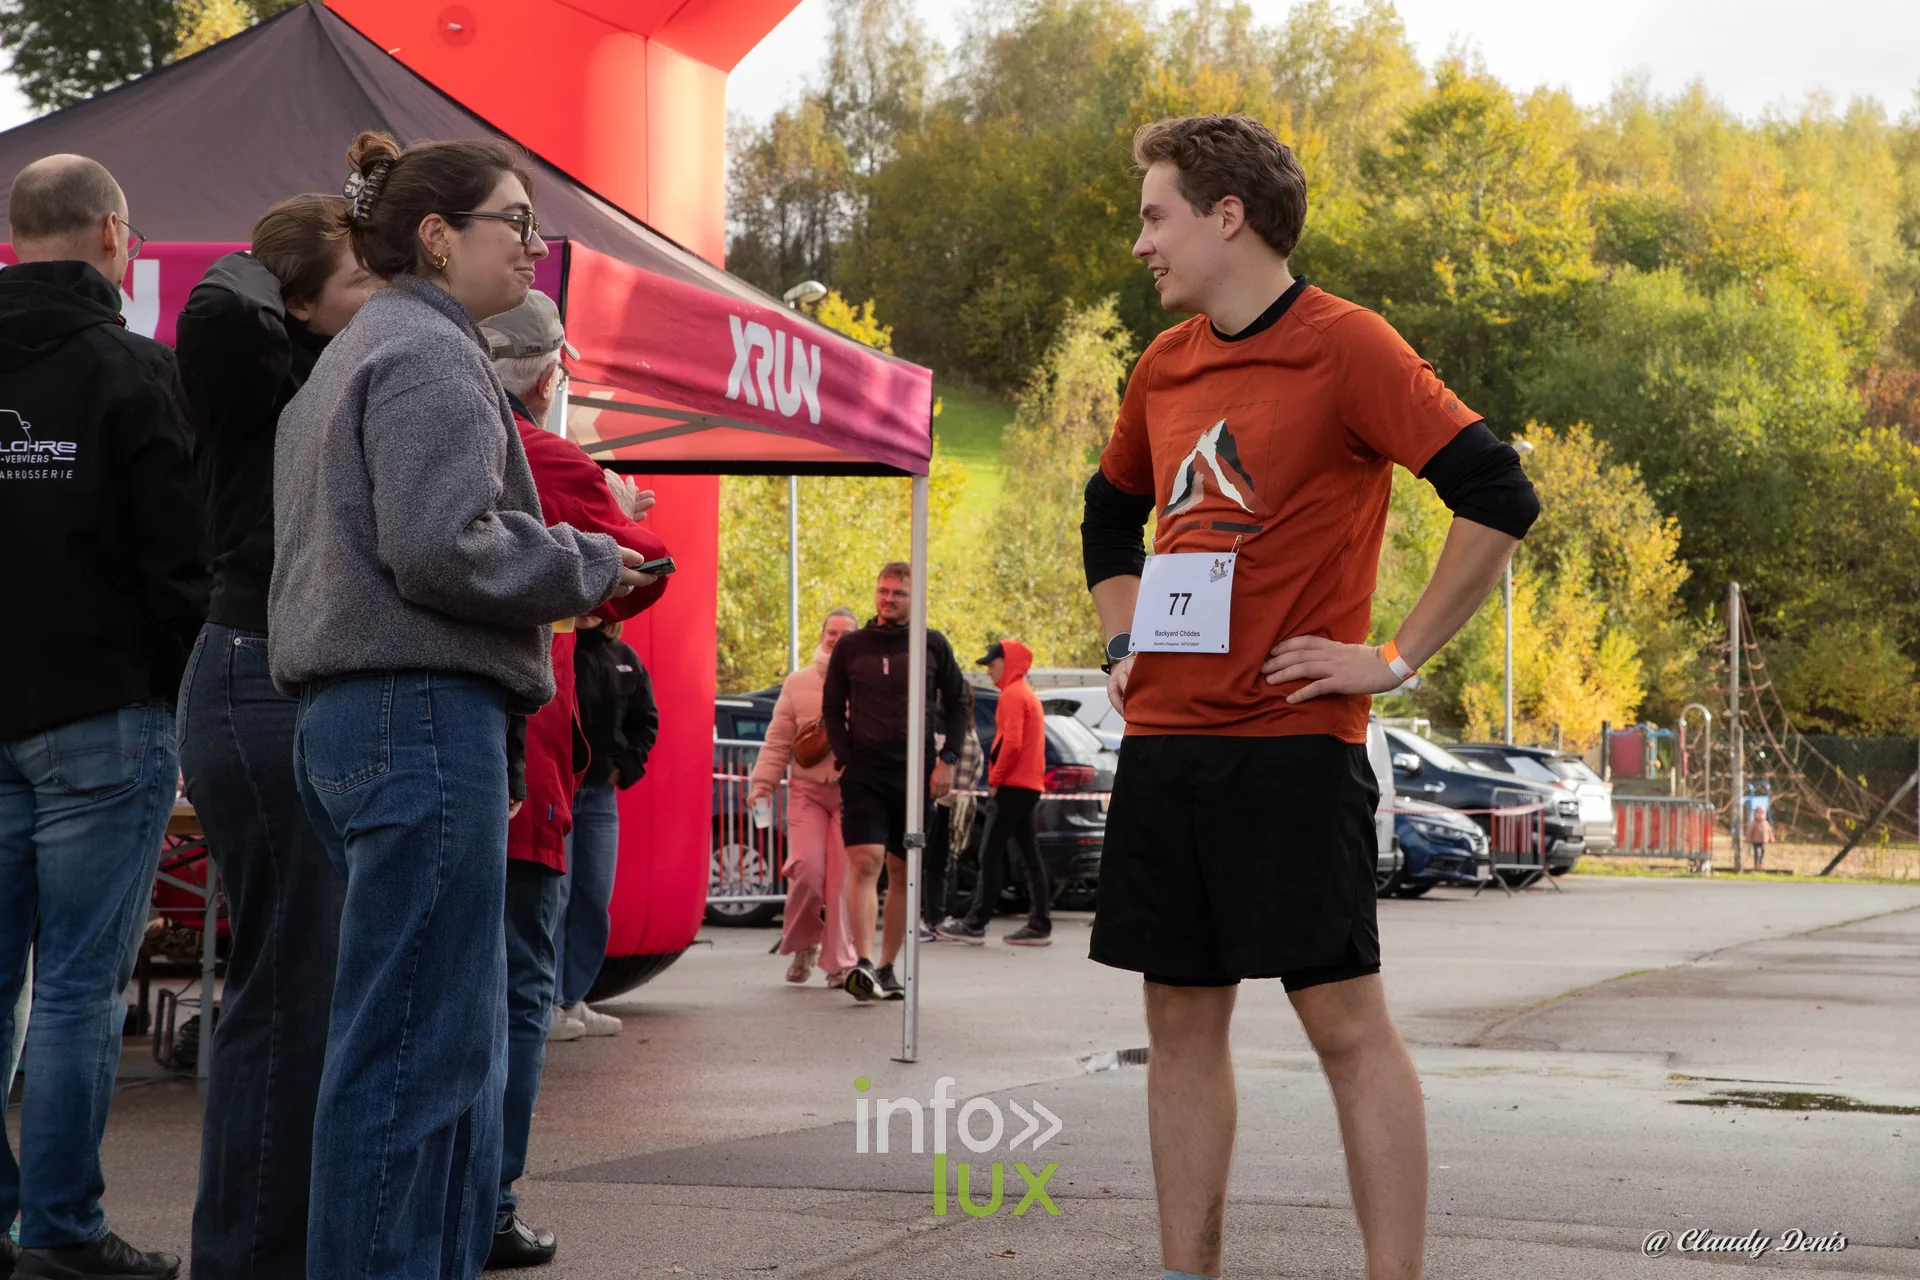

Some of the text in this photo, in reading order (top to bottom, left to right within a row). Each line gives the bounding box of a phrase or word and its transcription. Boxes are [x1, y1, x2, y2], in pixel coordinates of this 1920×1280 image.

[725, 315, 821, 425] XRUN
[1169, 593, 1192, 616] 77
[1155, 630, 1179, 638] Backyard
